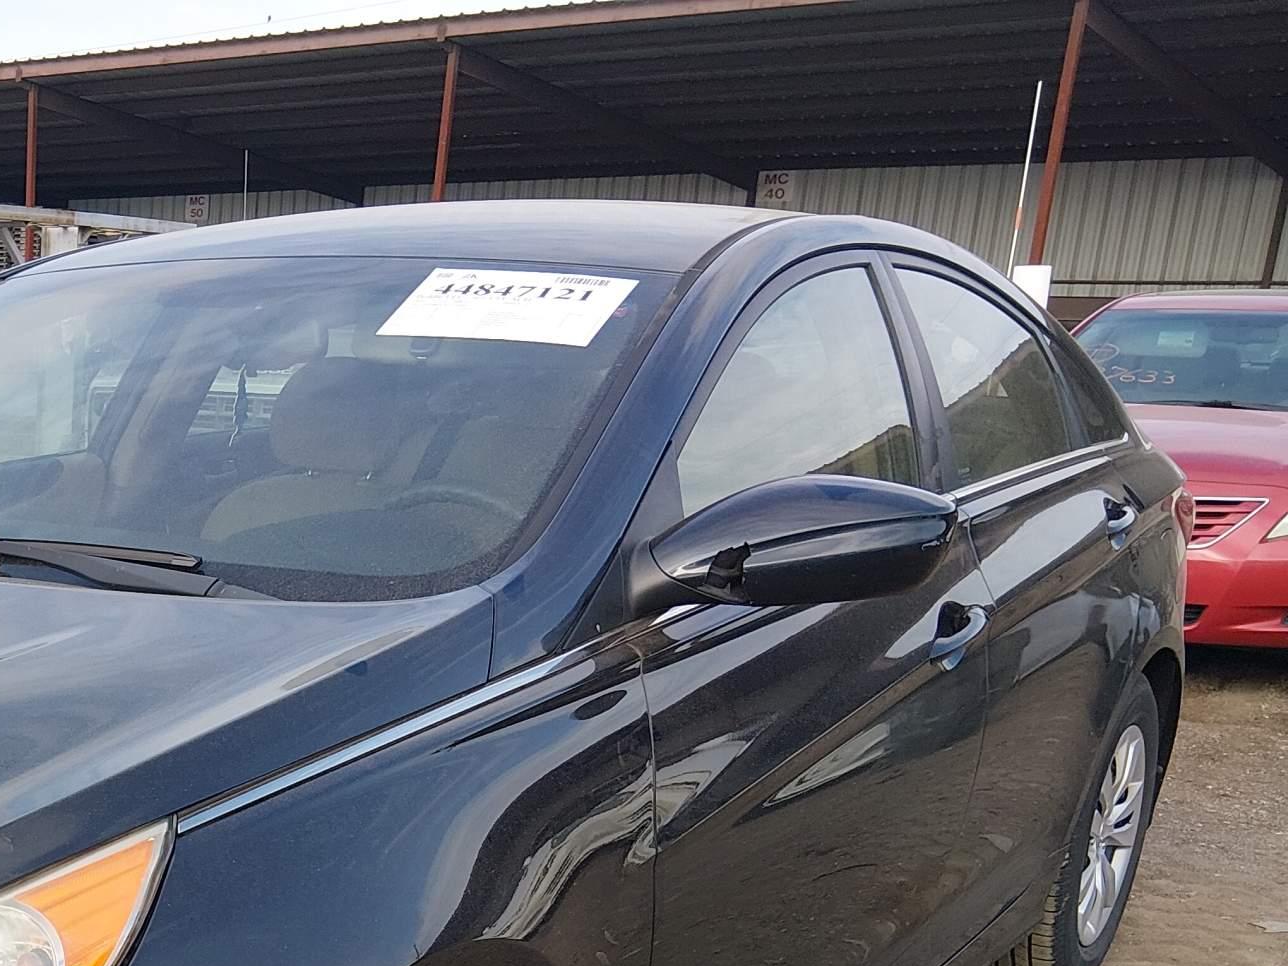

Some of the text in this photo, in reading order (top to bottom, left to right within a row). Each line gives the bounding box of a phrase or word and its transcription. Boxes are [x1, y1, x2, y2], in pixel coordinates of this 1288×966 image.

[764, 172, 789, 185] MC
[764, 188, 785, 199] 40
[189, 196, 205, 206] MC
[190, 208, 204, 218] 50
[433, 281, 594, 303] 44847121
[1098, 365, 1177, 385] 7633
